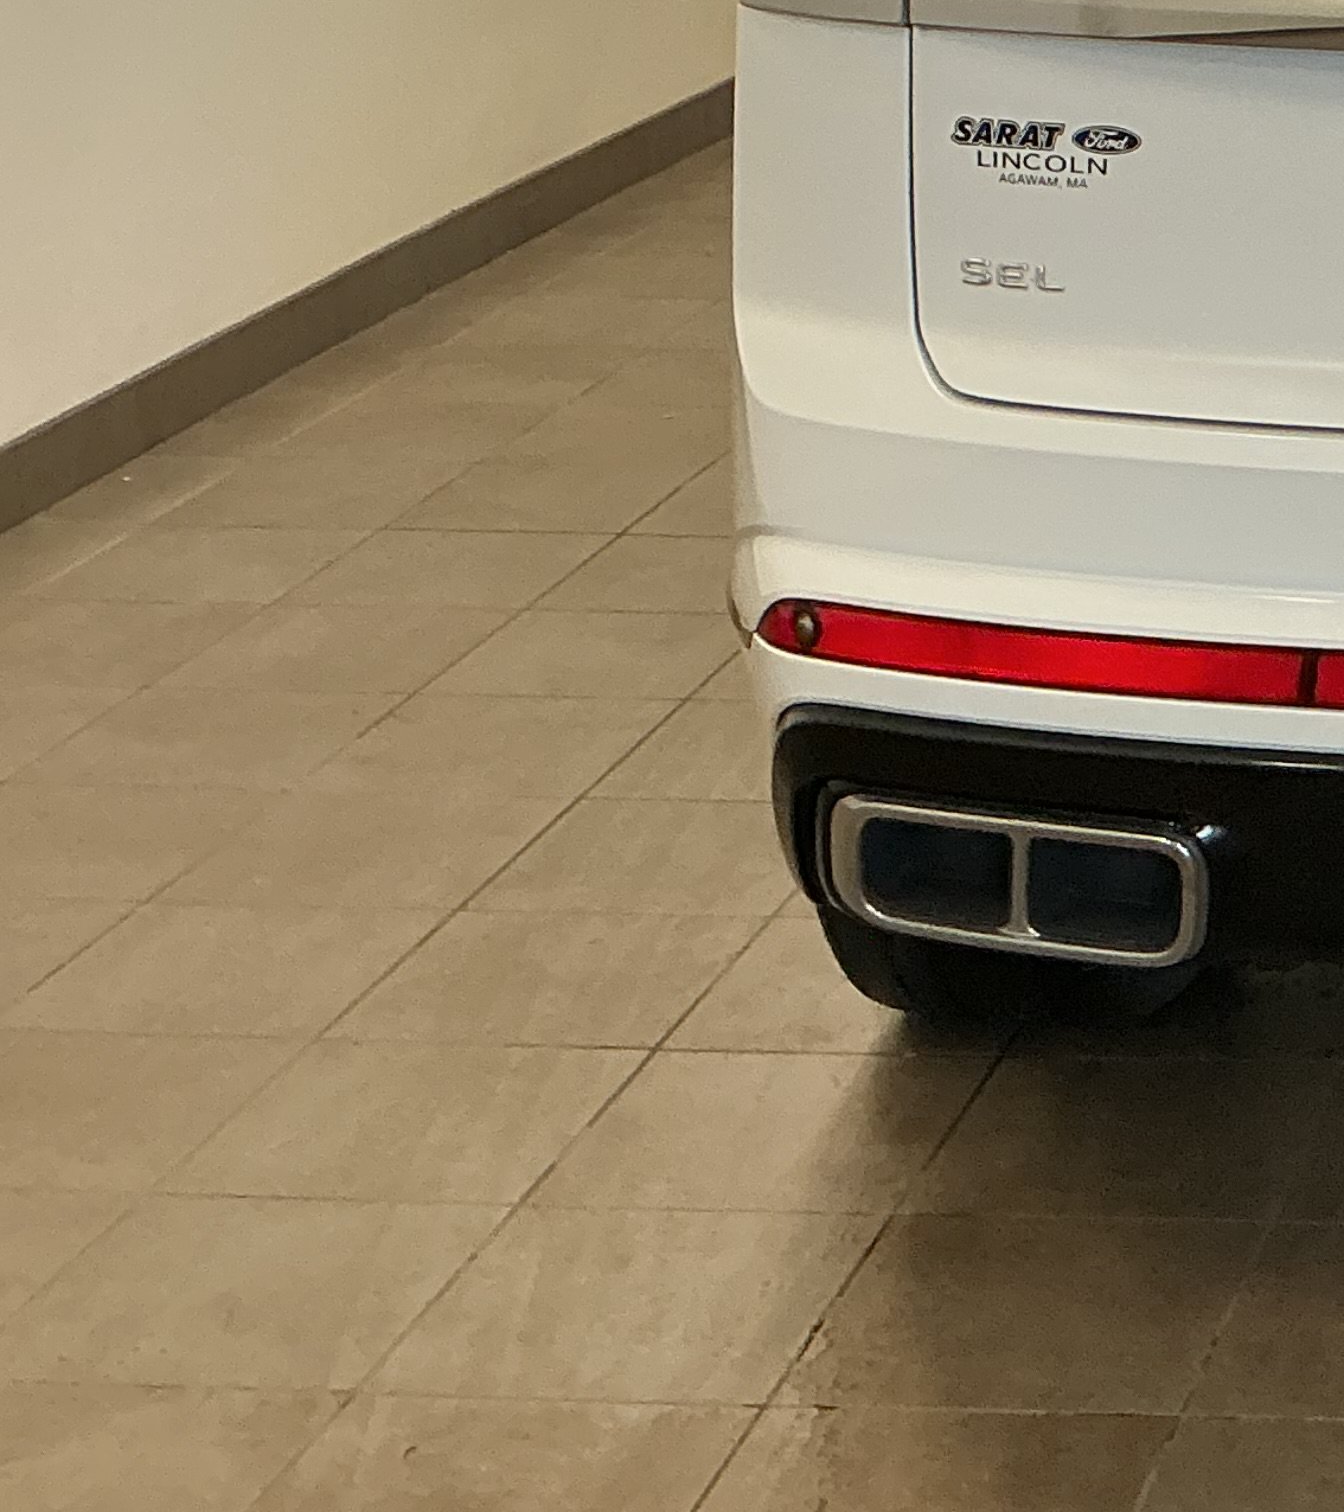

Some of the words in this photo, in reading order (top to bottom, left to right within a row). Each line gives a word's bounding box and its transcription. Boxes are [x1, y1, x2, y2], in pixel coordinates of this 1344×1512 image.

[952, 117, 1065, 149] SARAT
[1081, 128, 1131, 151] Ford
[977, 150, 1108, 176] LINCOLN
[1066, 177, 1088, 189] MA
[960, 257, 1066, 292] SEL
